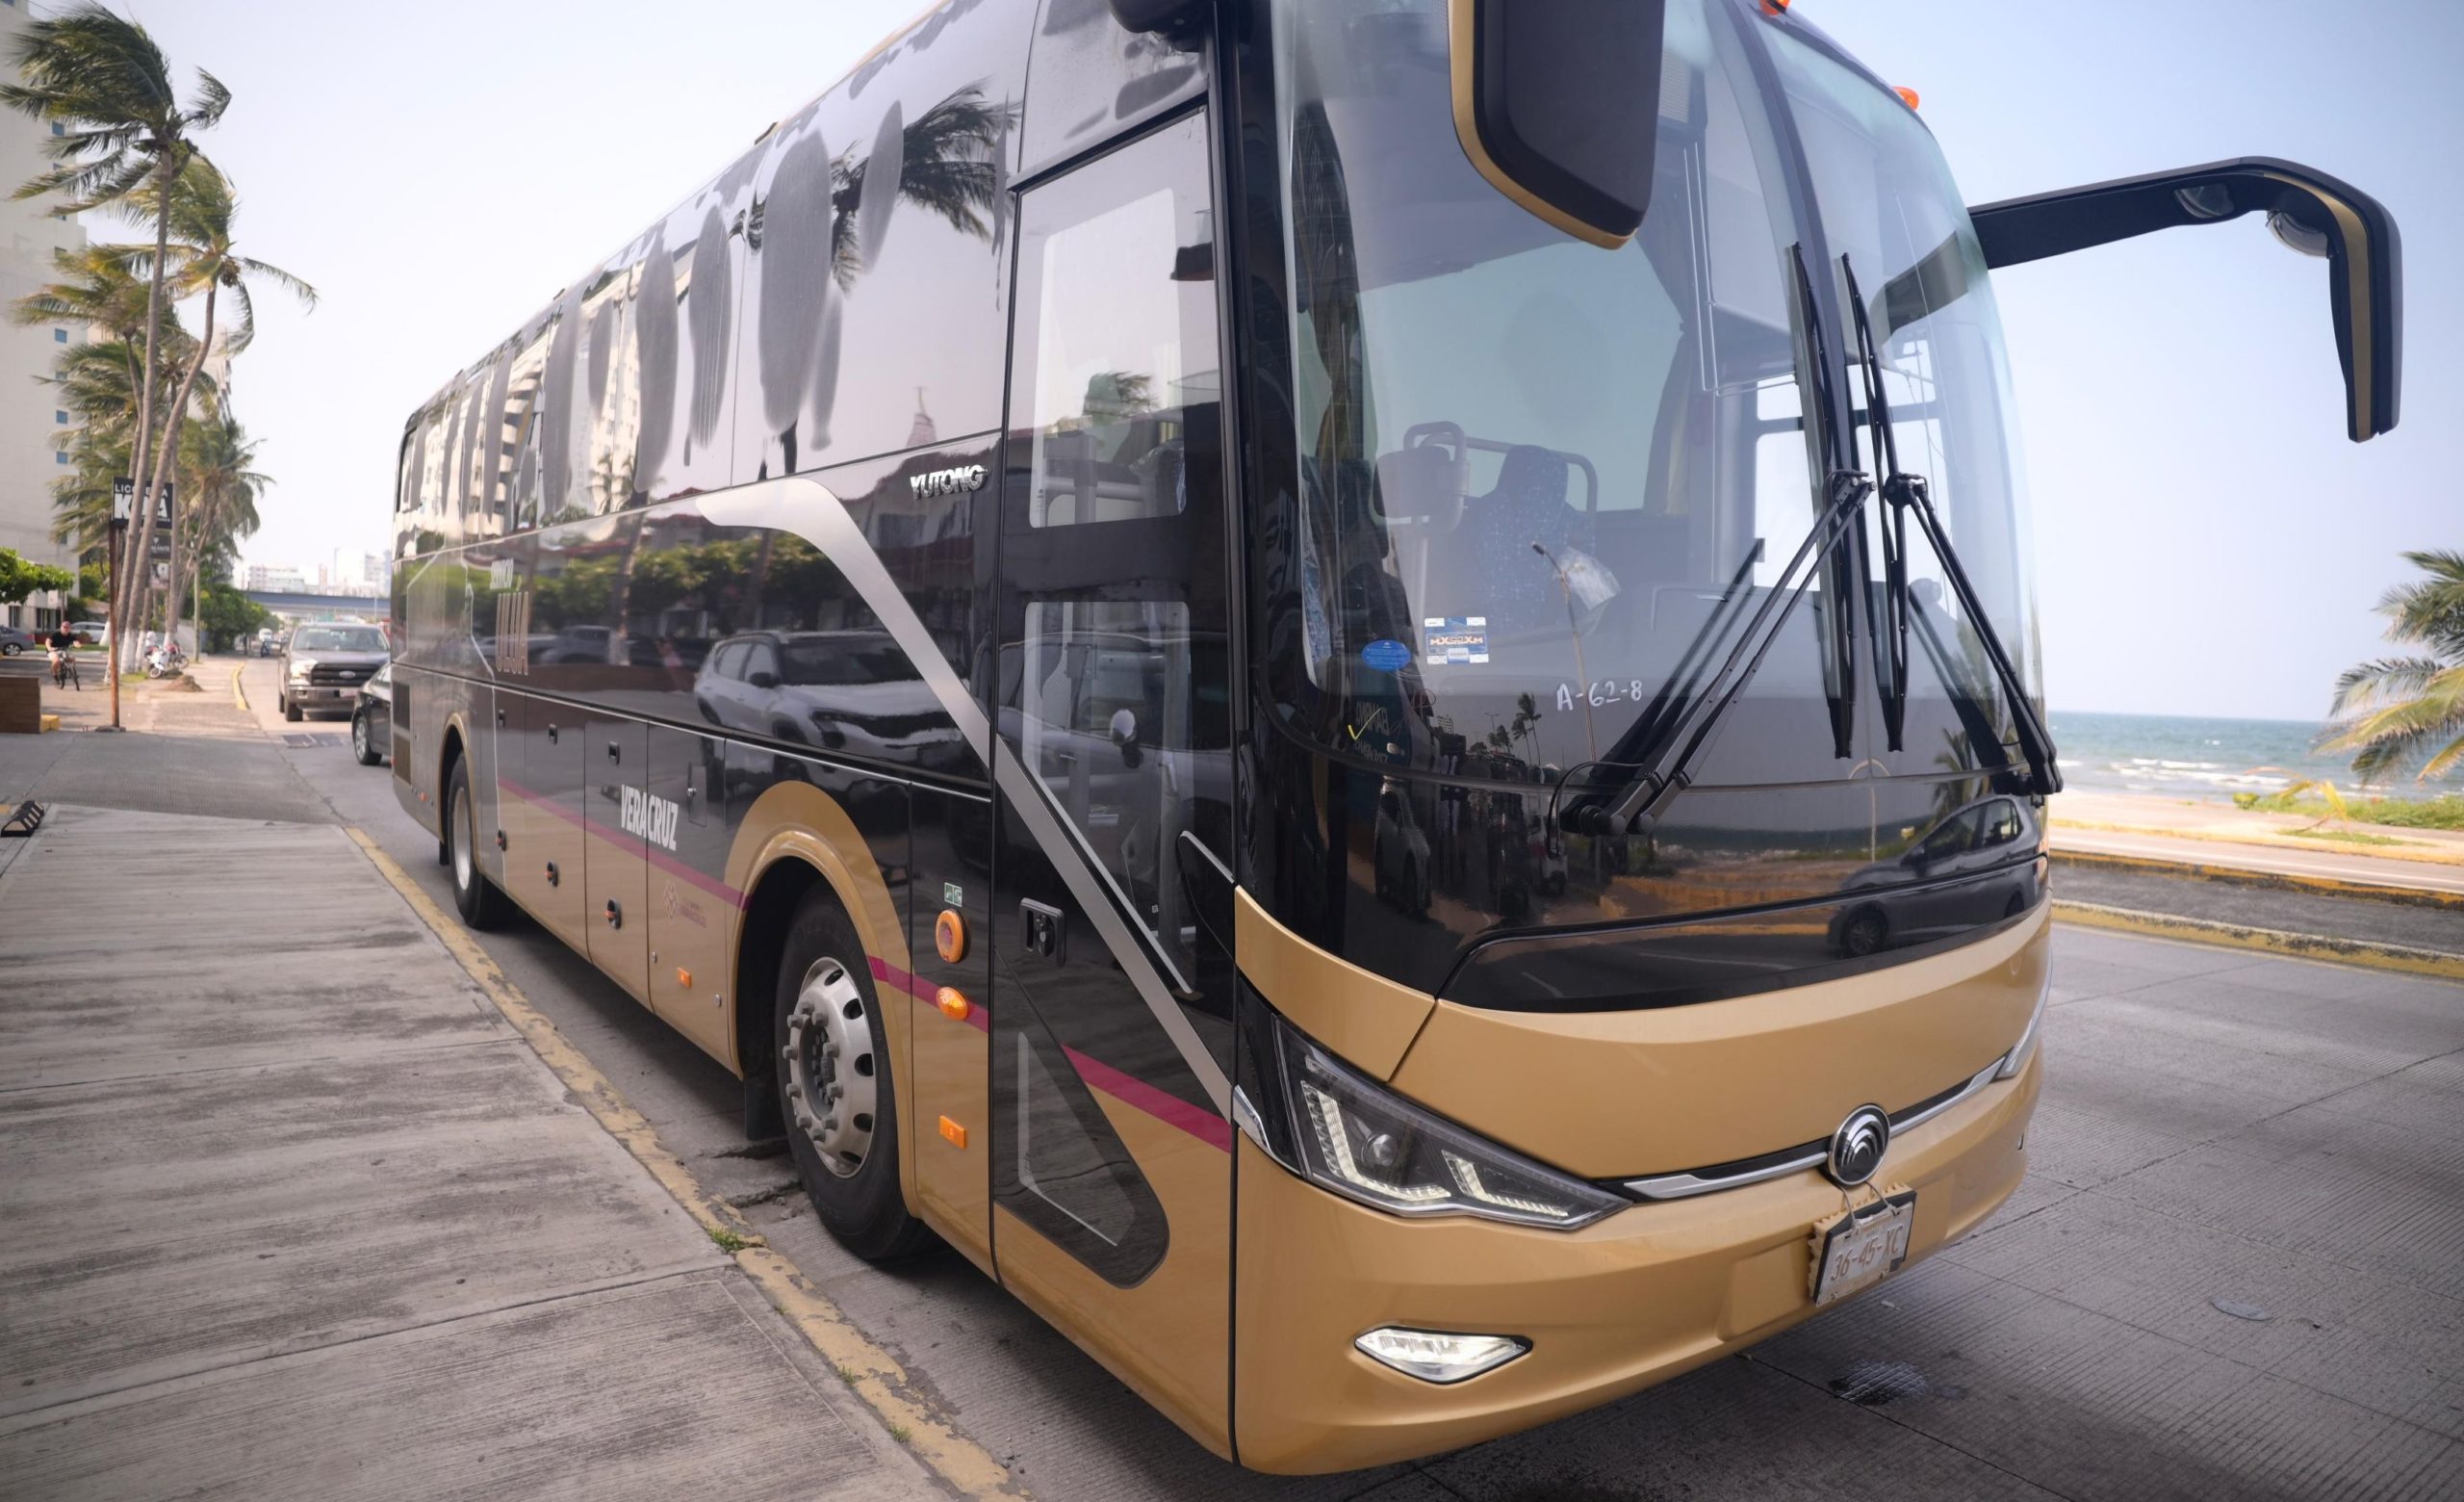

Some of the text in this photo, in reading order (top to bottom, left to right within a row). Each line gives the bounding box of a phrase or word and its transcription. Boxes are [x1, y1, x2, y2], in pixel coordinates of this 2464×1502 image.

[910, 464, 987, 500] YUTONG
[1556, 680, 1642, 711] A-62-8
[621, 784, 679, 851] VERACRUZ
